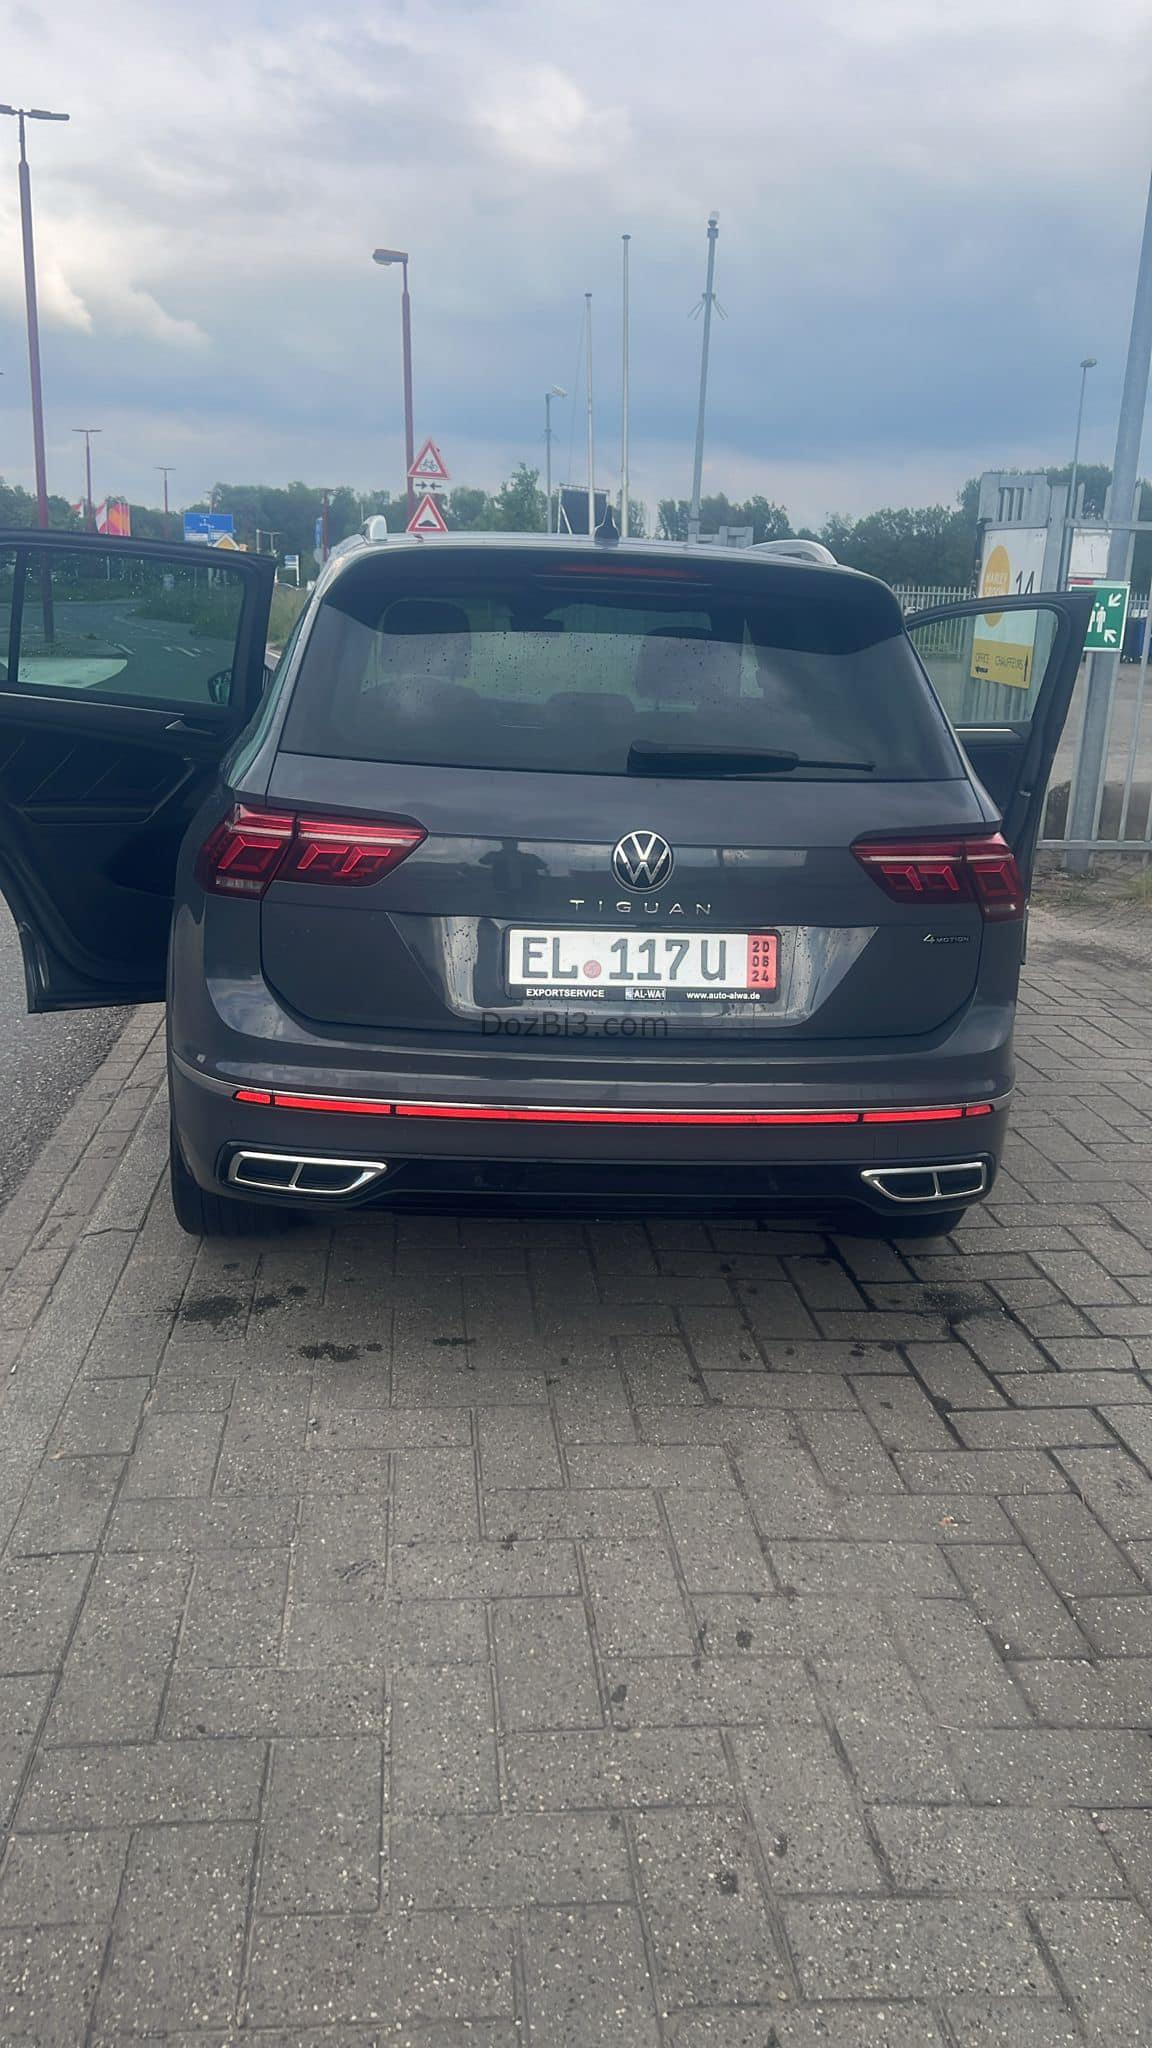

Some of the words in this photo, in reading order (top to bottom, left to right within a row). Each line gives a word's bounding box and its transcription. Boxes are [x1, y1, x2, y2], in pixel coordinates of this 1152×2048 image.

[569, 899, 711, 915] TIGUAN
[923, 934, 969, 943] 4MOTION
[522, 936, 578, 979] EL
[752, 970, 769, 982] 24
[526, 988, 605, 998] EXPORTSERVICE
[686, 991, 761, 1000] www.auto-alwa.de
